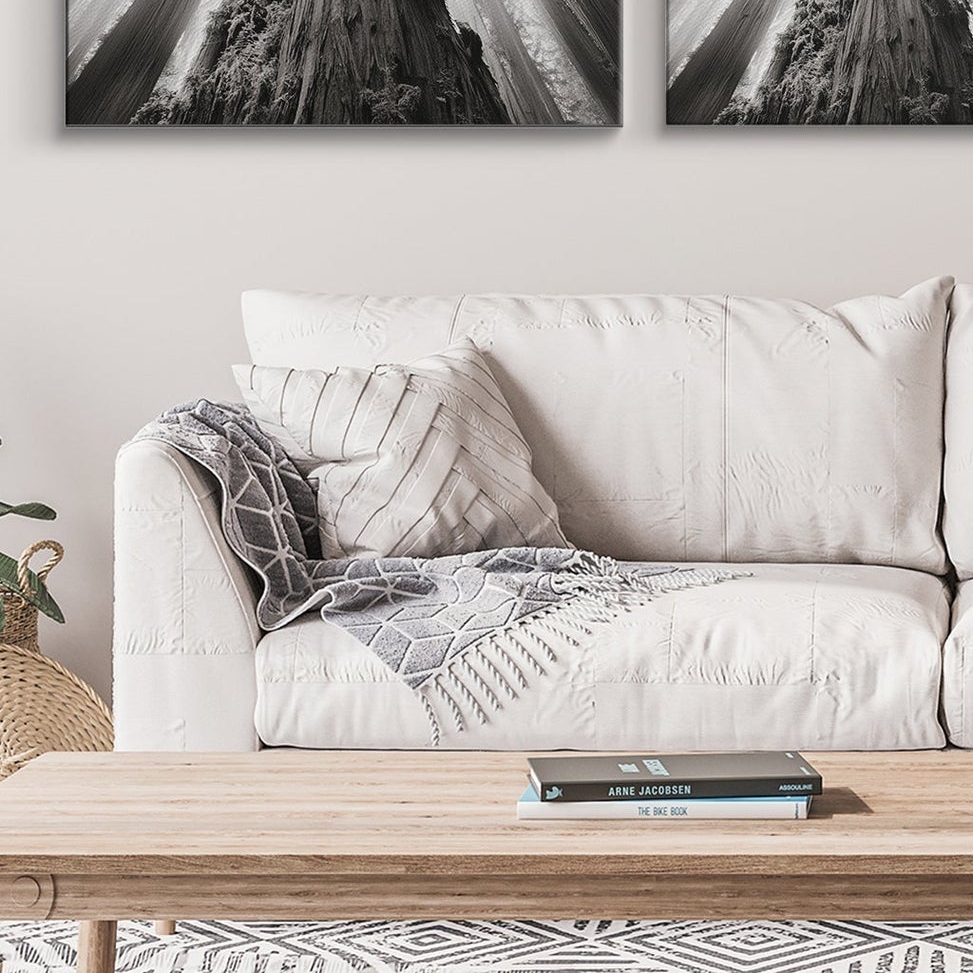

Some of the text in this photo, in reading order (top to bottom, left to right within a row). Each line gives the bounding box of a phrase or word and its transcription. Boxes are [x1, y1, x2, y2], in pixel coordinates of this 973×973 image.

[608, 785, 691, 796] ARNE JACOBSEN
[638, 806, 688, 816] THE BIKE BOOK
